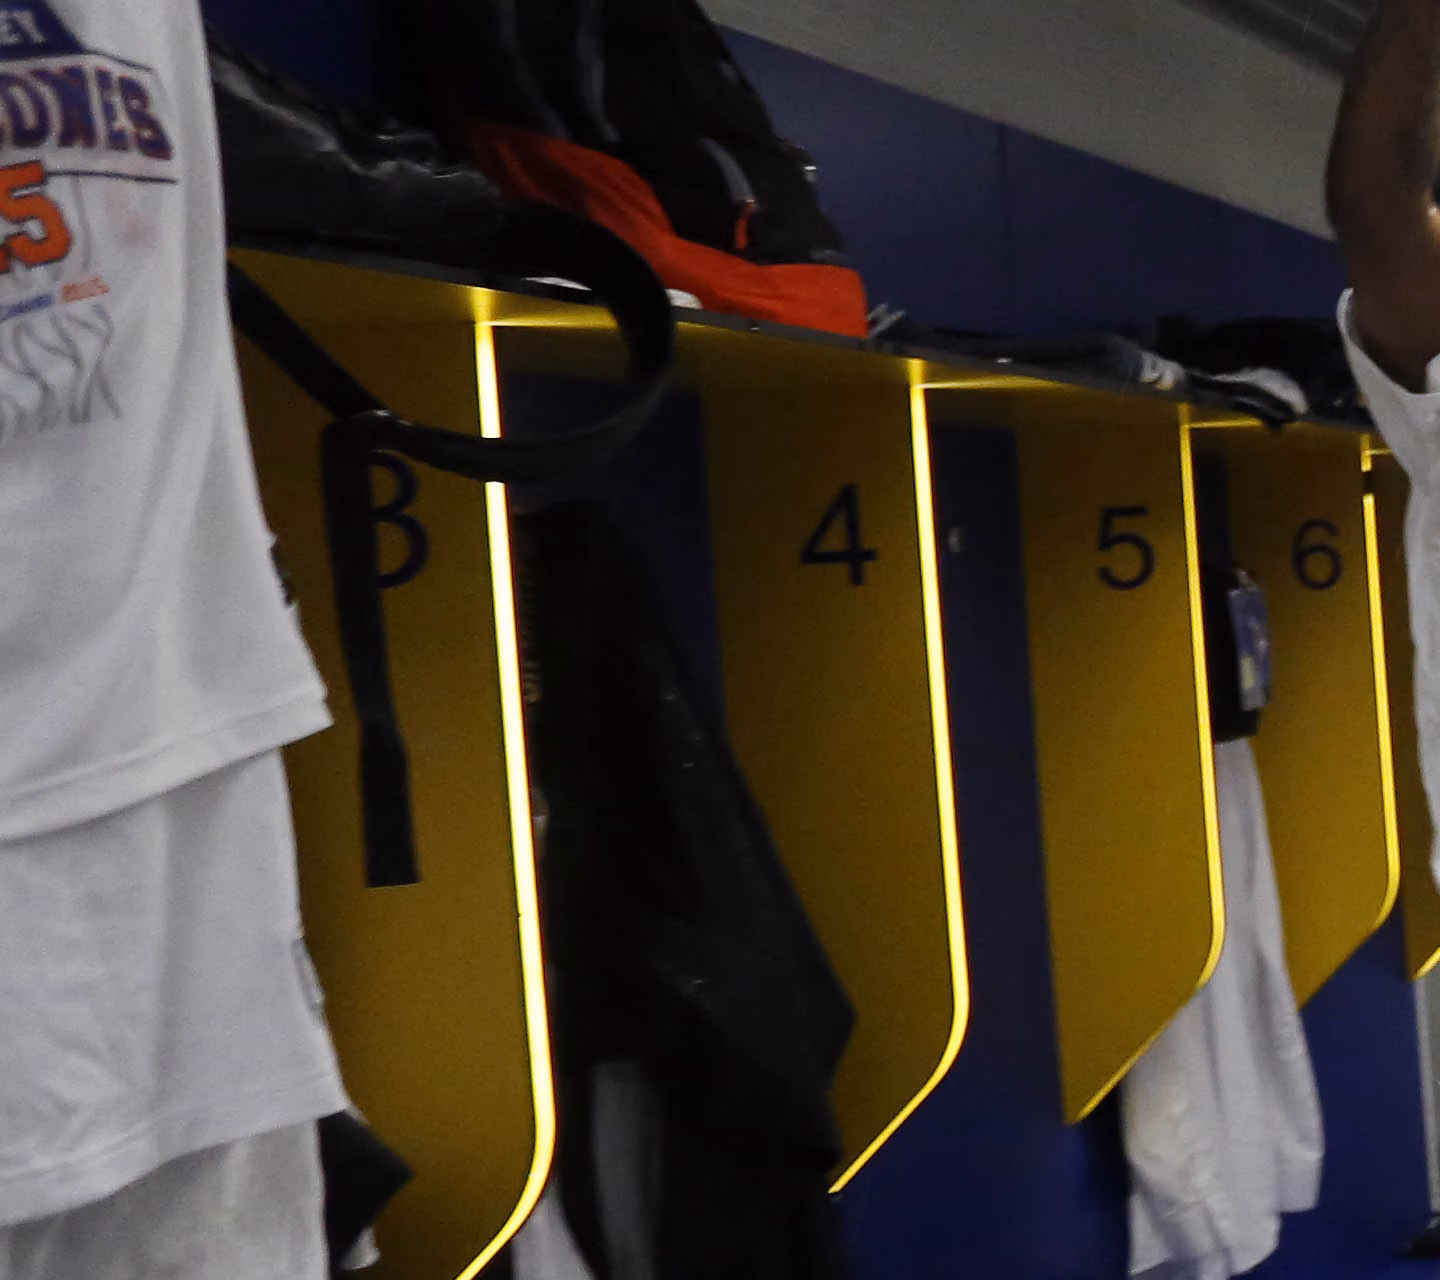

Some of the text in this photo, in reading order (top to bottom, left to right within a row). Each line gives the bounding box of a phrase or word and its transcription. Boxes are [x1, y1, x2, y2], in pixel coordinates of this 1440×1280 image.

[0, 64, 174, 160] ONES
[0, 160, 73, 273] 5
[802, 483, 878, 588] 4
[1096, 506, 1156, 591] 5
[1291, 518, 1343, 591] 6
